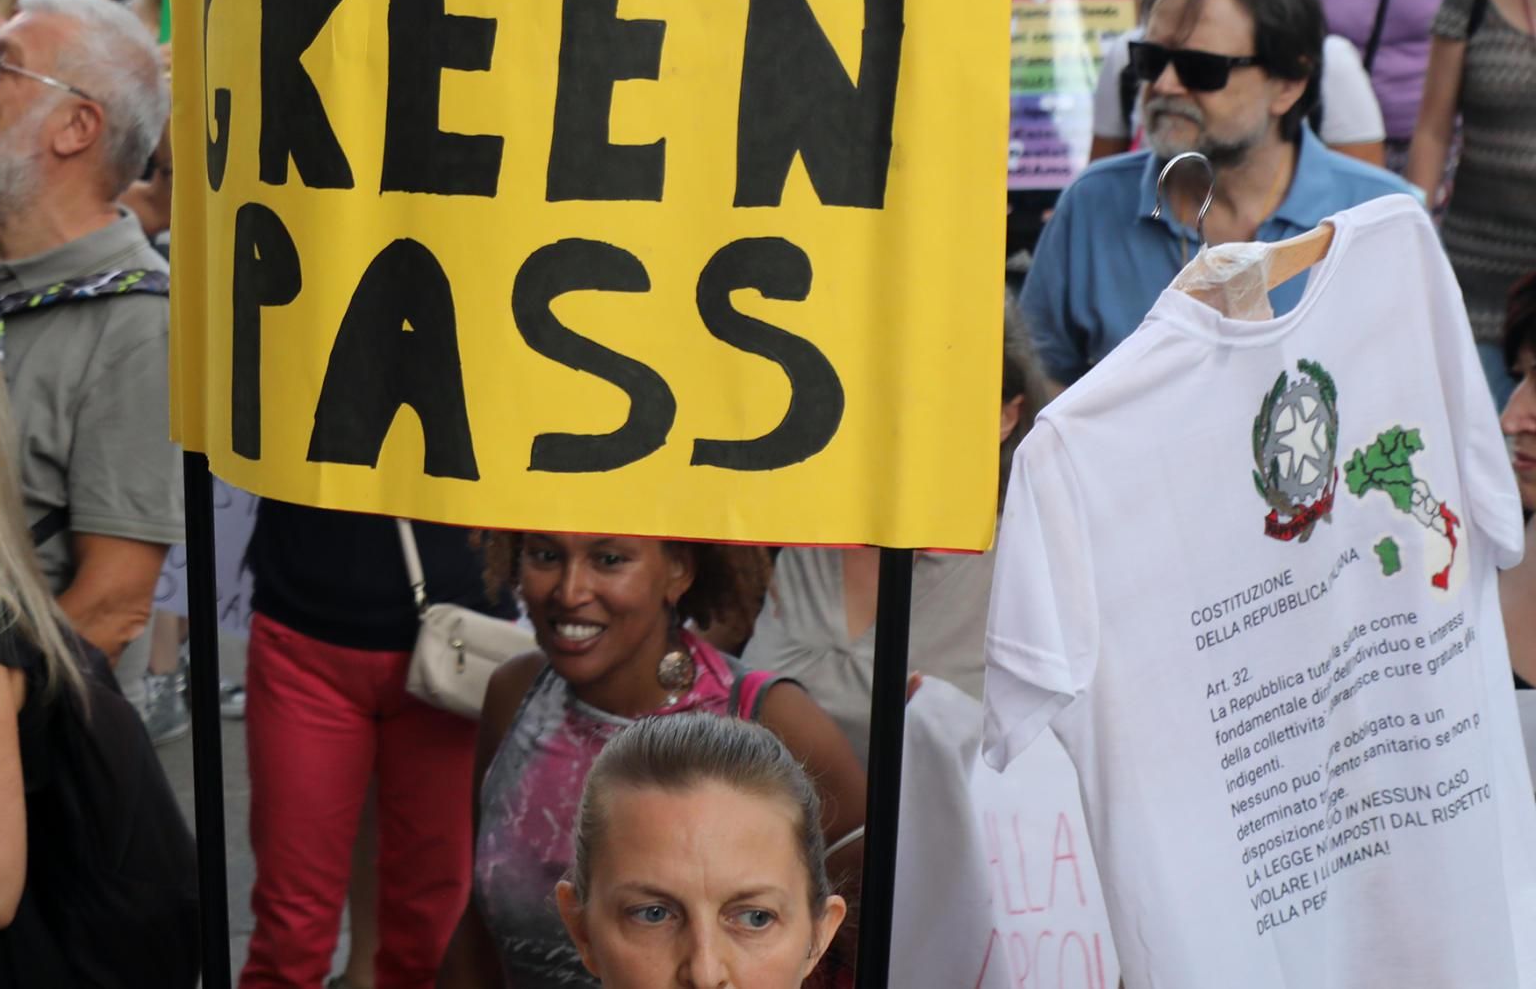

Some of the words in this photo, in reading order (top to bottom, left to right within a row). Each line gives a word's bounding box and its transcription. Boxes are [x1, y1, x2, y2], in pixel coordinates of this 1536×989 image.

[231, 201, 846, 481] PASS
[1191, 569, 1294, 626] COSTITUZIONE
[1195, 621, 1241, 651] DELLA
[1243, 581, 1328, 631] REPUBBLICA
[1206, 678, 1231, 700] Art.
[1210, 706, 1227, 723] La
[1229, 672, 1305, 714] Repubblica
[1370, 611, 1418, 632] come
[1215, 696, 1308, 746] fondamentale
[1415, 636, 1426, 649] e
[1221, 746, 1251, 771] della
[1384, 662, 1423, 679] cure
[1225, 754, 1285, 794] indigenti.
[1230, 781, 1288, 818] Nessuno
[1409, 713, 1421, 727] a
[1424, 707, 1445, 724] un
[1236, 796, 1318, 842] determinato
[1363, 735, 1432, 762] sanitario
[1435, 730, 1452, 747] se
[1241, 818, 1326, 865] disposizione
[1245, 868, 1262, 890] LA
[1263, 846, 1314, 879] LEGGE
[1345, 801, 1359, 820] IN
[1361, 785, 1432, 812] NESSUN
[1436, 768, 1470, 798] CASO
[1250, 873, 1312, 912] VIOLARE
[1389, 811, 1428, 830] DAL
[1431, 783, 1491, 824] RISPETTO
[1256, 904, 1300, 937] DELLA
[1331, 840, 1391, 874] UMANA!
